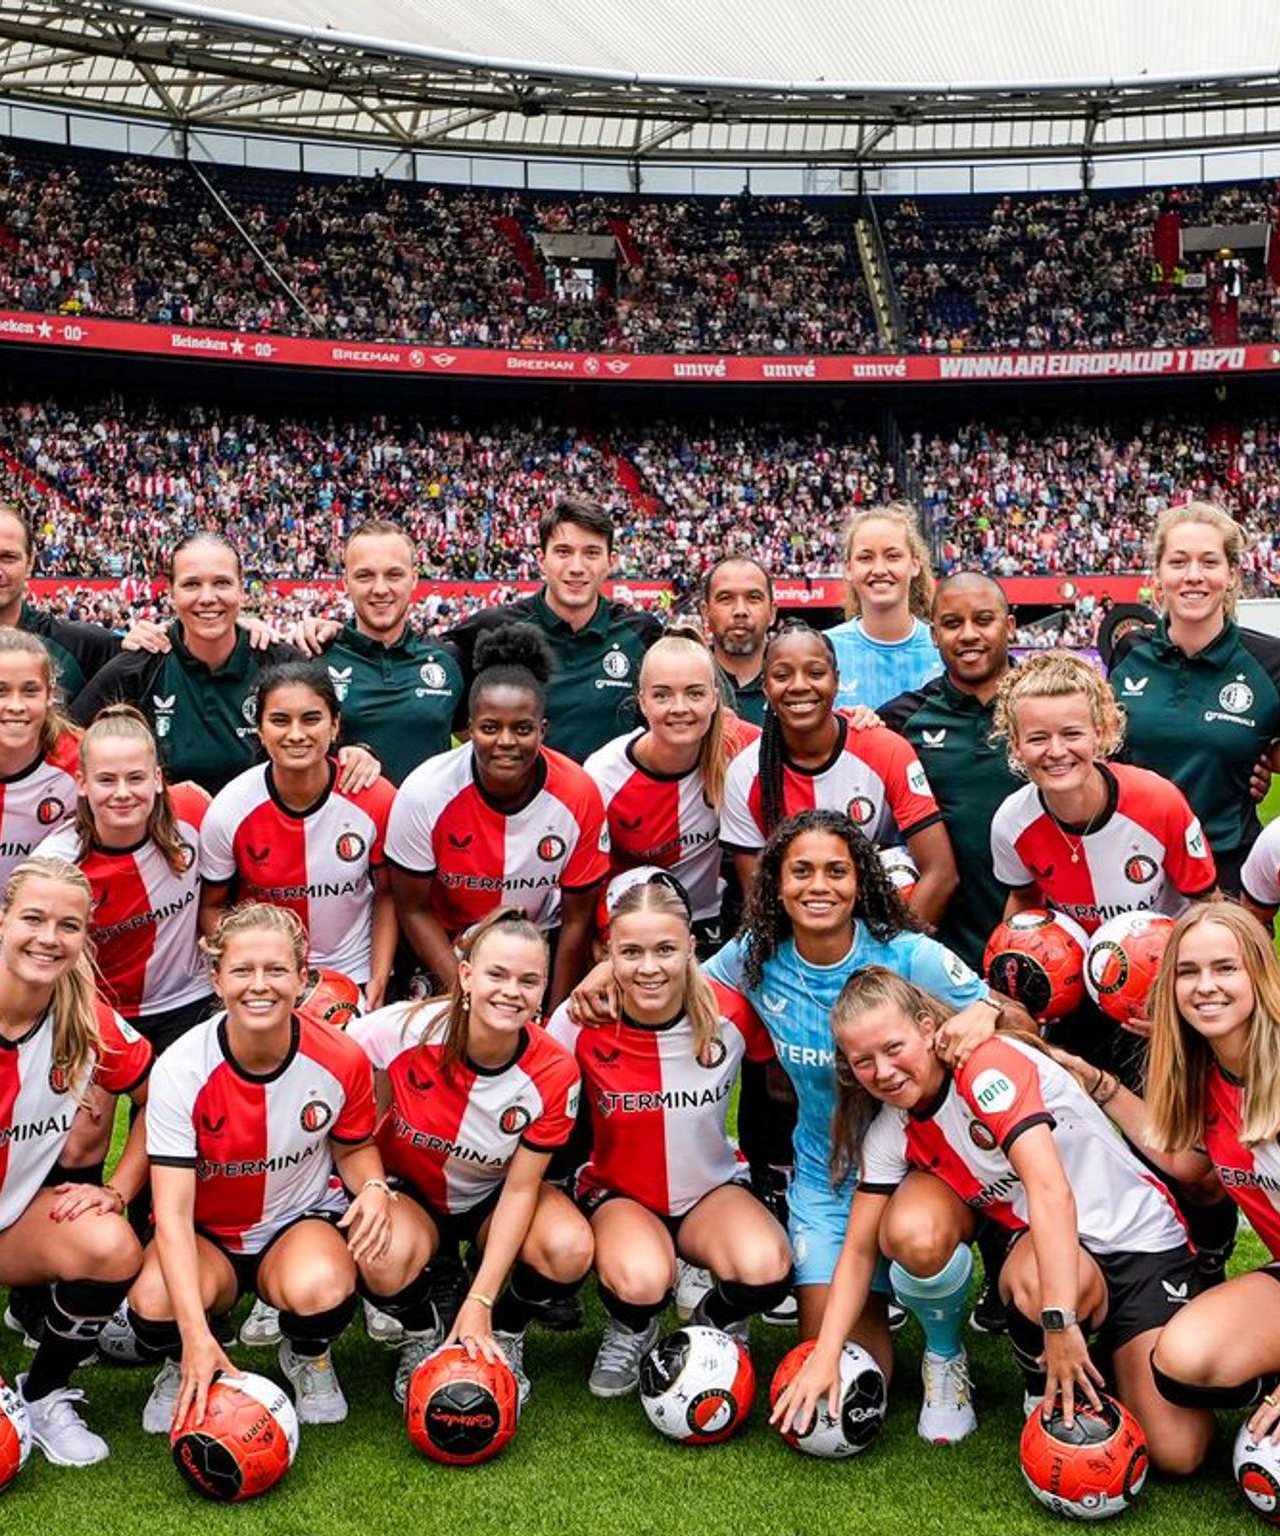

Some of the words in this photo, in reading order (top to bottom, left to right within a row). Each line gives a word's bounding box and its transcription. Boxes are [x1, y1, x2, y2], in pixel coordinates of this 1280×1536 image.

[172, 333, 228, 351] Heineken
[332, 348, 400, 363] BREEMAN
[506, 356, 574, 371] BREEMAN
[939, 354, 1045, 378] WINNAAR
[1046, 351, 1172, 377] EUROPACUP
[1191, 347, 1246, 371] 1970
[673, 359, 726, 377] univé
[762, 359, 816, 378] univé
[853, 358, 907, 378] univé
[978, 1077, 1010, 1108] TOTO
